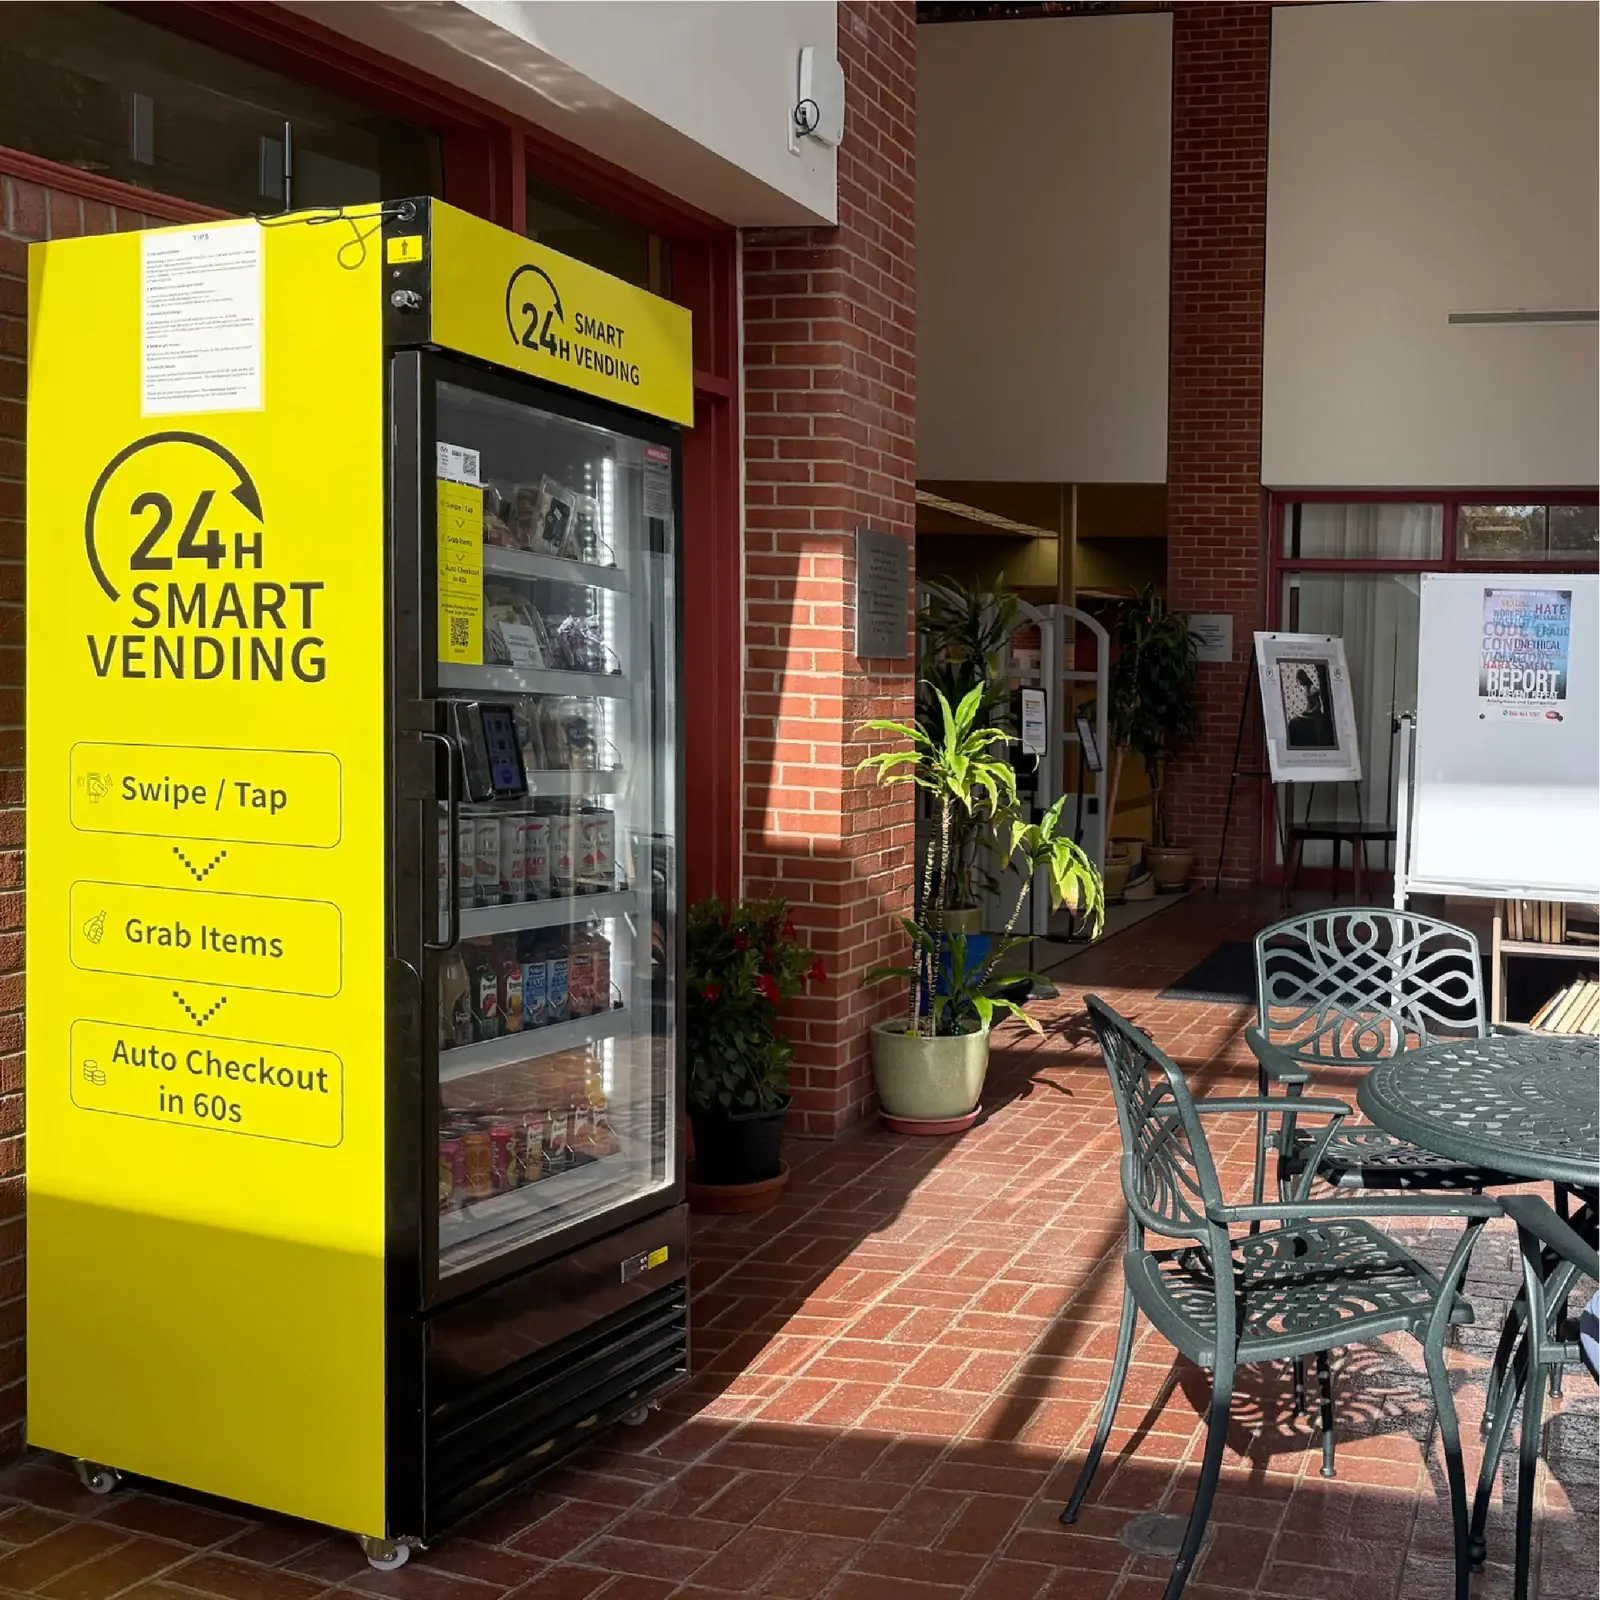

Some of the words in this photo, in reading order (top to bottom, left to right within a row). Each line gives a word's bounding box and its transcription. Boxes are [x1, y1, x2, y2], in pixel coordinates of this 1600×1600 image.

[574, 312, 625, 349] SMART
[574, 343, 640, 387] VENDING
[132, 583, 324, 629] SMART
[1535, 604, 1566, 615] HATE
[87, 636, 326, 683] VENDING
[1486, 668, 1561, 693] REPORT
[121, 774, 207, 810] Swipe
[215, 778, 226, 813] /
[233, 780, 288, 816] Tap
[125, 918, 192, 949] Grab
[201, 925, 284, 959] Items
[112, 1039, 177, 1071] Auto
[185, 1049, 329, 1094] Checkout
[159, 1084, 184, 1115] in
[193, 1092, 243, 1123] 60s
